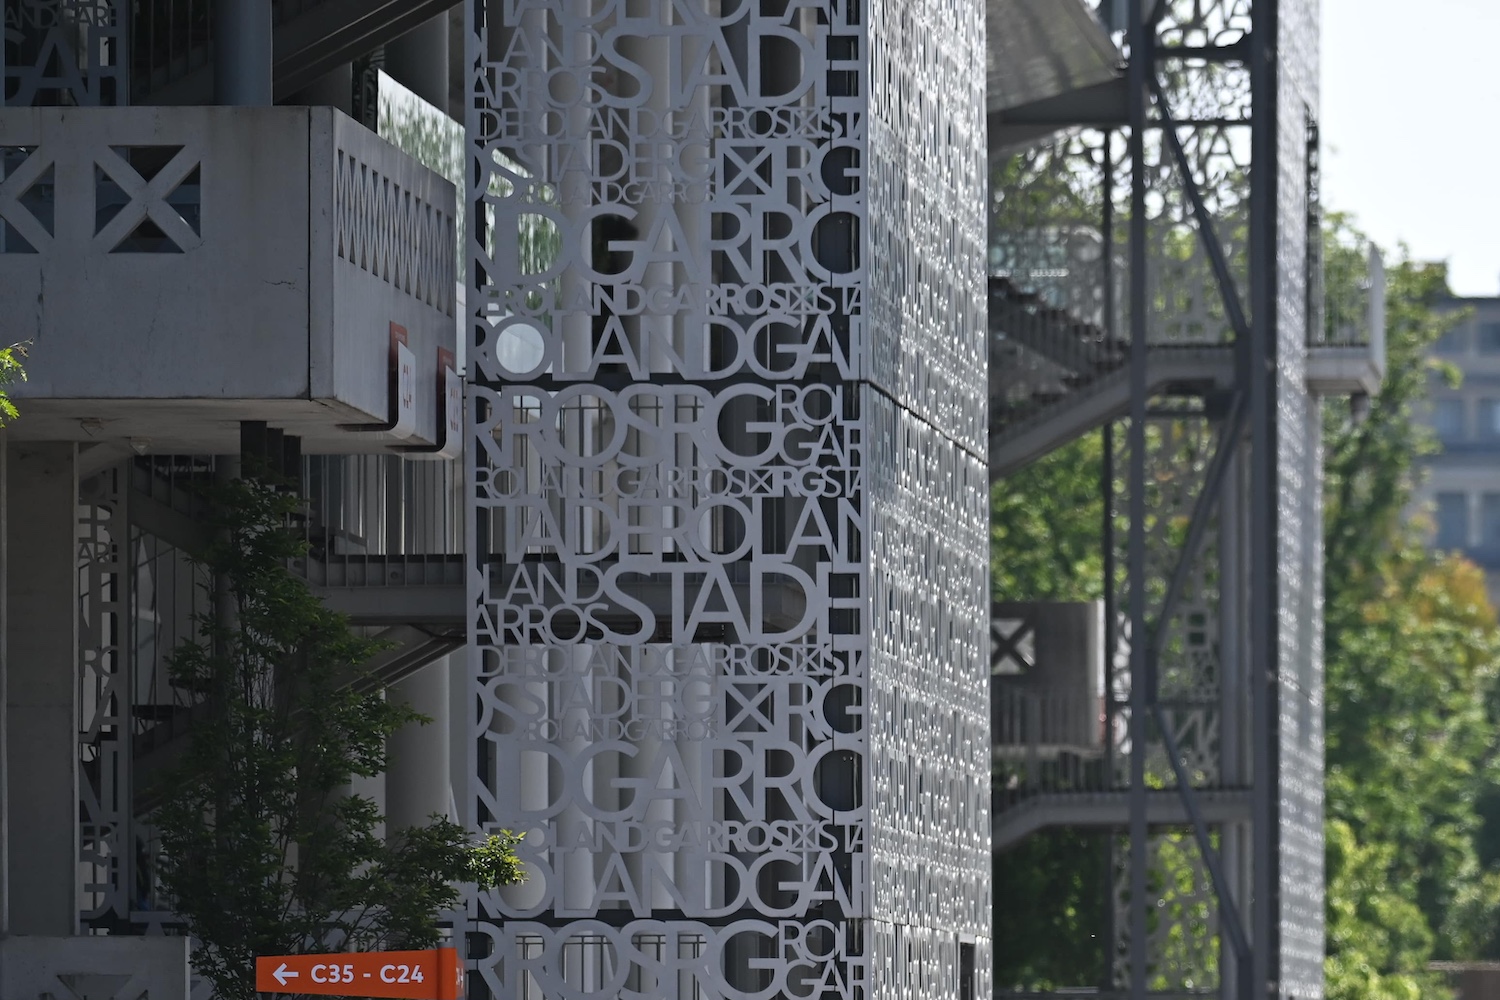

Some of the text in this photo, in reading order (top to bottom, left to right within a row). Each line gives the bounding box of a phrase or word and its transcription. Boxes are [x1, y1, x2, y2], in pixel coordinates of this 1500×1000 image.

[475, 27, 602, 67] LAND
[600, 25, 860, 108] STADE
[467, 315, 860, 381] ROLANDGA
[476, 563, 604, 605] LAND
[602, 561, 862, 645] STADE
[310, 964, 354, 984] C35
[379, 964, 424, 984] C24
